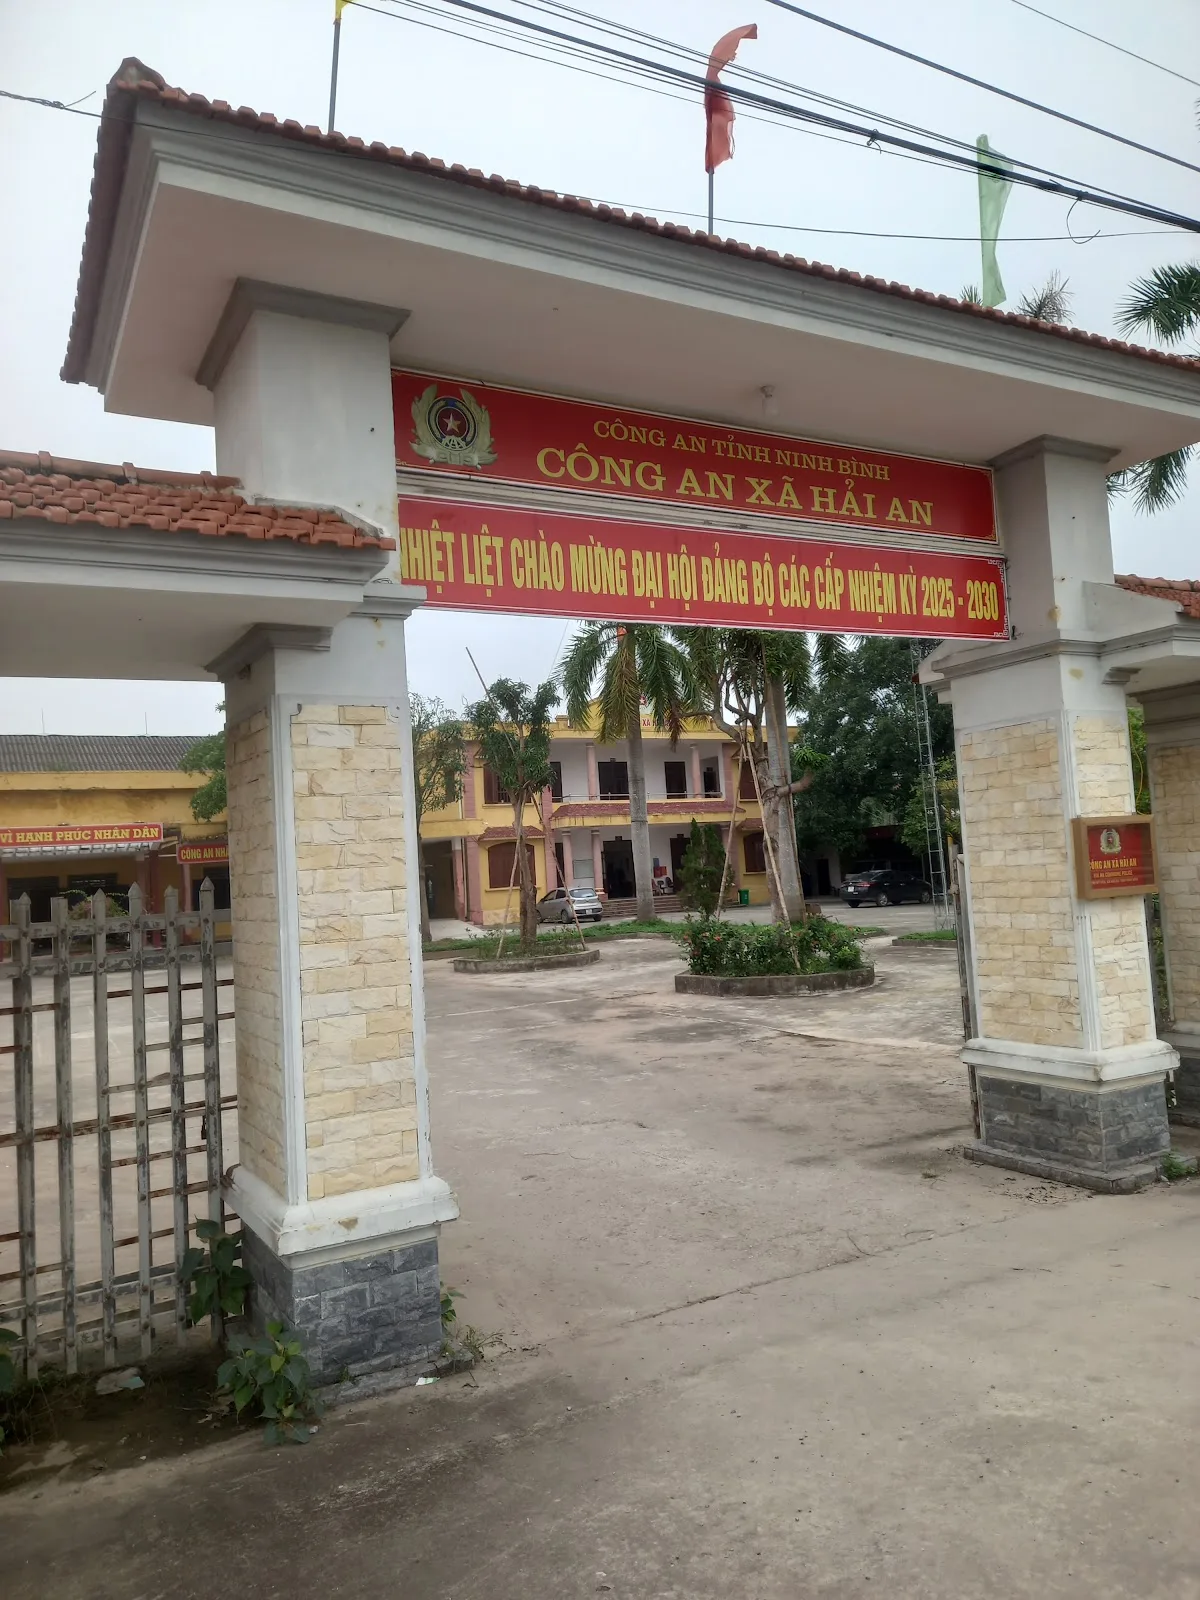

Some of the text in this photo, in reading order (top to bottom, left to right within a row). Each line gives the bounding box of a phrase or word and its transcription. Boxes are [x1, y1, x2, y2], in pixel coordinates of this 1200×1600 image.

[593, 418, 890, 480] CÔNG AN TỈNH NINH BÌNH
[536, 443, 933, 526] CÔNG AN XÃ HẢI AN
[461, 524, 504, 597] LIỆT
[510, 529, 564, 592] CHÀO
[569, 535, 628, 596] MỪNG
[631, 550, 664, 608] ĐẠI
[667, 544, 698, 611] HỘI
[701, 542, 749, 605] ĐẢNG
[752, 552, 775, 616] BỘ
[778, 554, 811, 609] CÁC
[814, 552, 844, 611] CẤP
[848, 562, 897, 623] NHIỆM
[899, 565, 918, 615] KỲ
[921, 575, 955, 618] 2025
[958, 597, 964, 606] -
[966, 579, 999, 621] 2030
[0, 826, 159, 845] VÌ HẠNH PHÚC NHÂN DÂN
[203, 848, 214, 858] AN
